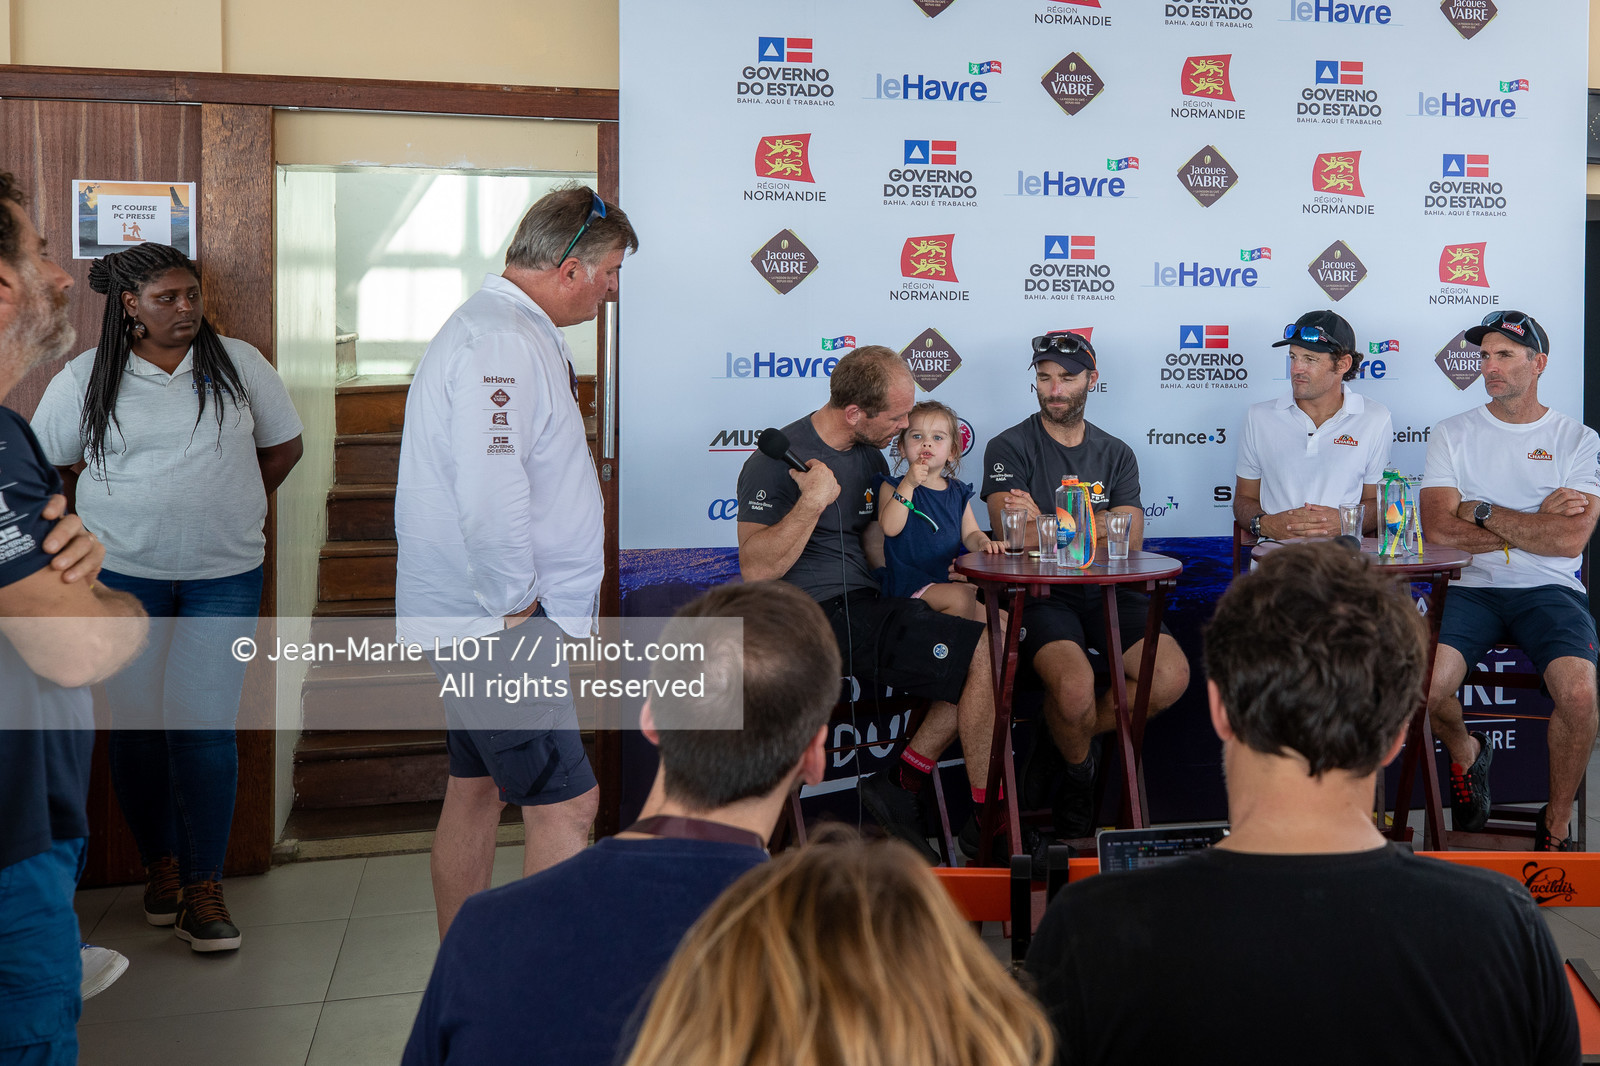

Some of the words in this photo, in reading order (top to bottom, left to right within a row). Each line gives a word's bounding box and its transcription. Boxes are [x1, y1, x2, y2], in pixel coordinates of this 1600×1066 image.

[1165, 4, 1190, 18] DO
[1192, 6, 1252, 20] ESTADO
[1449, 6, 1488, 21] VABRE
[1034, 14, 1112, 26] NORMANDIE
[742, 66, 830, 82] GOVERNO
[1054, 72, 1092, 82] Jacques
[737, 82, 764, 96] DO
[767, 82, 834, 98] ESTADO
[1050, 82, 1094, 96] VABRE
[1302, 88, 1378, 102] GOVERNO
[1170, 108, 1246, 120] NORMANDIE
[1297, 103, 1320, 116] DO
[1323, 104, 1382, 117] ESTADO
[888, 168, 972, 183] GOVERNO
[1190, 165, 1226, 176] Jacques
[1186, 174, 1228, 188] VABRE
[1429, 181, 1502, 194] GOVERNO
[744, 190, 826, 202] NORMANDIE
[884, 184, 910, 198] DO
[912, 185, 977, 198] ESTADO
[1424, 196, 1448, 208] DO
[1450, 196, 1506, 208] ESTADO
[1302, 204, 1375, 214] NORMANDIE
[766, 250, 806, 260] Jacques
[761, 260, 808, 274] VABRE
[1030, 264, 1110, 278] GOVERNO
[1320, 260, 1356, 270] Jacques
[1317, 268, 1358, 283] VABRE
[1024, 278, 1050, 292] DO
[1052, 279, 1114, 292] ESTADO
[890, 290, 970, 300] NORMANDIE
[1429, 295, 1499, 304] NORMANDIE
[910, 348, 949, 360] Jacques
[1165, 353, 1244, 366] GOVERNO
[1446, 350, 1480, 360] Jacques
[906, 358, 952, 372] VABRE
[1444, 358, 1482, 372] VABRE
[1160, 368, 1184, 380] DO
[1187, 368, 1248, 380] ESTADO
